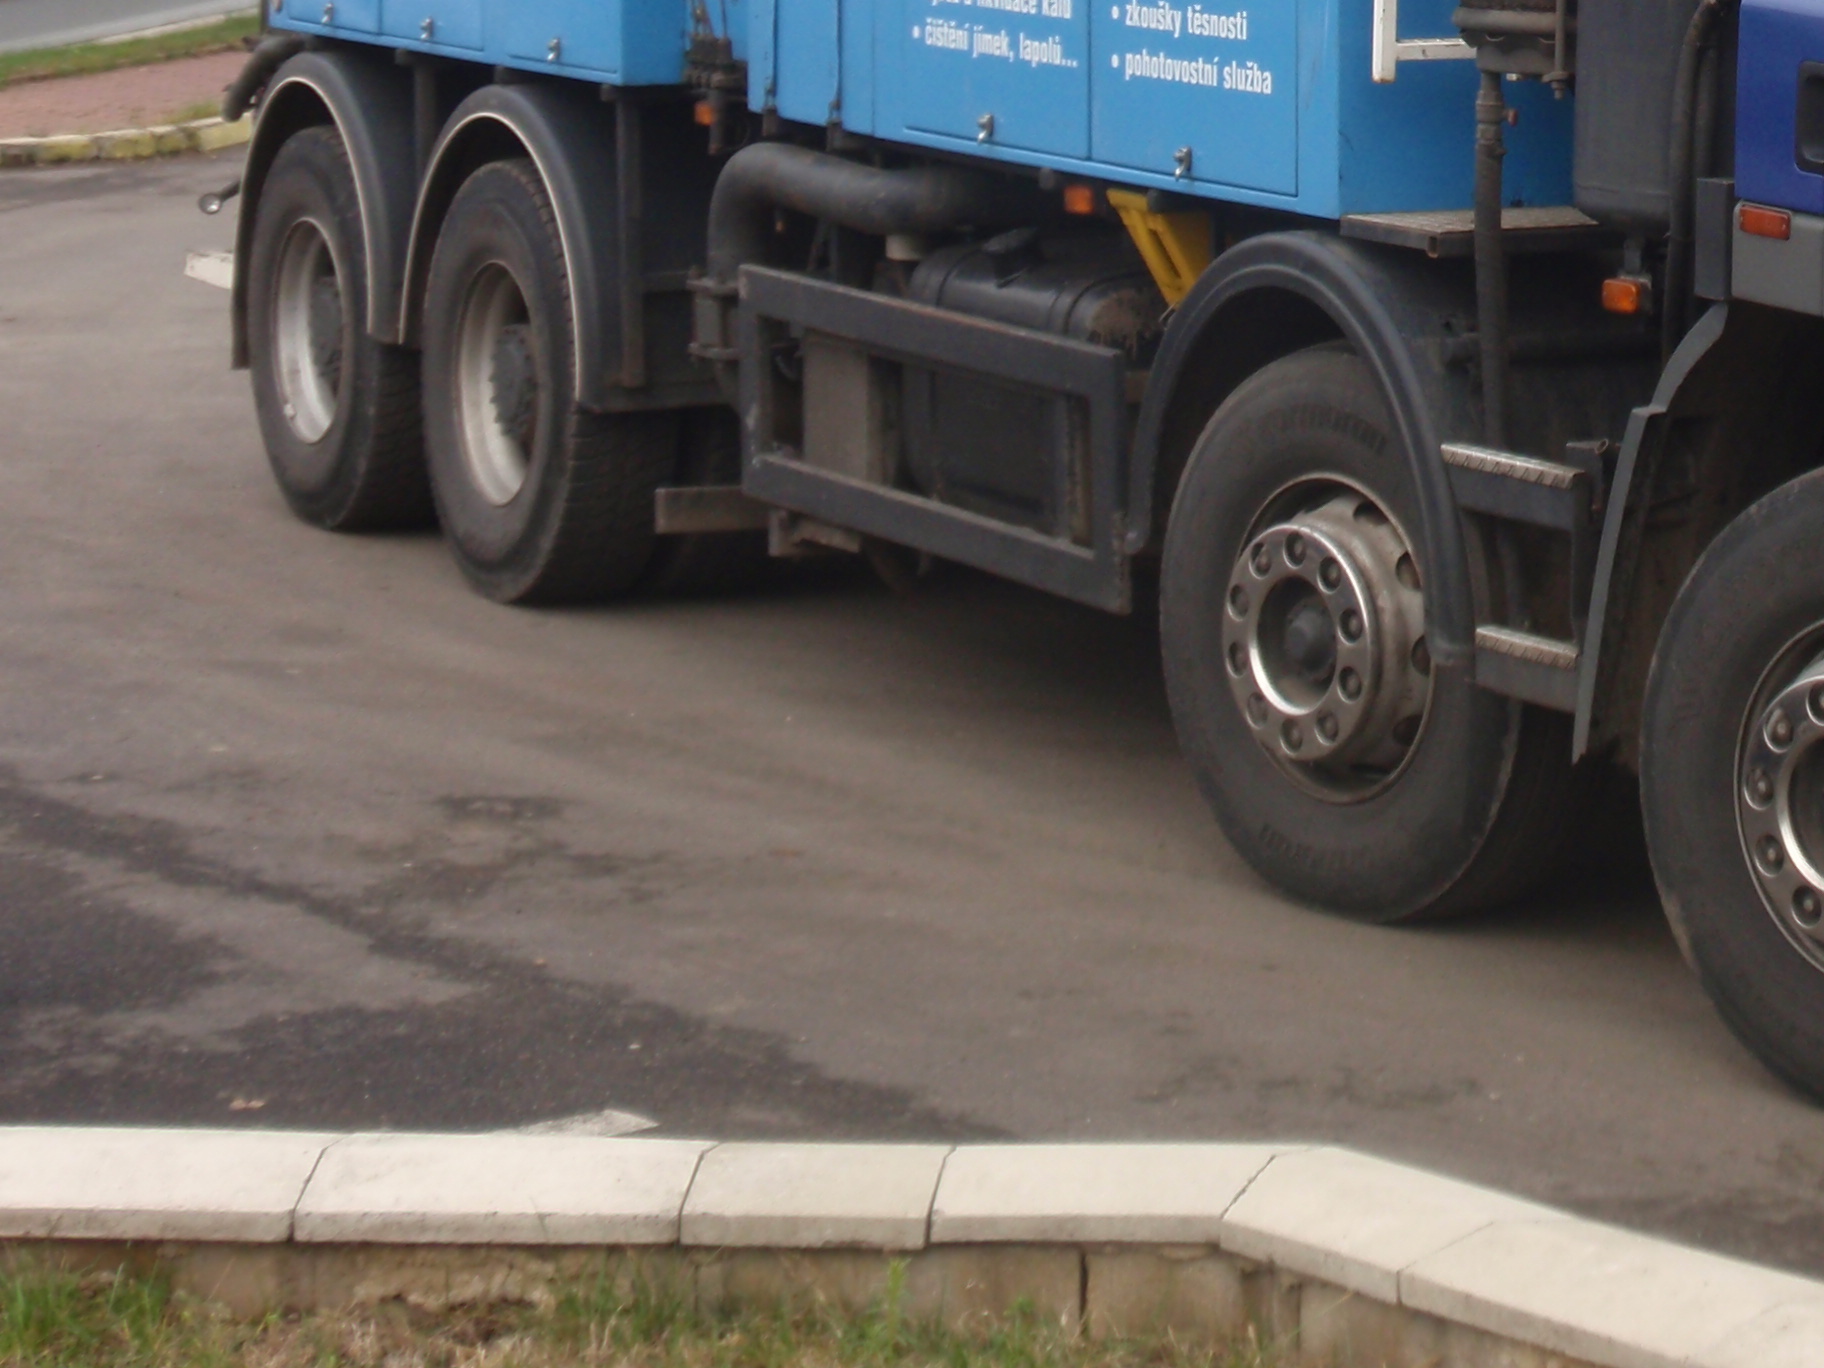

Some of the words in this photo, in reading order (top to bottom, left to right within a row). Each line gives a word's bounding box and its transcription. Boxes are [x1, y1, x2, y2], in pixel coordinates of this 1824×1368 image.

[924, 17, 969, 51] čištění
[1187, 4, 1248, 41] těsnosti
[1125, 48, 1220, 87] pohotovostní
[1223, 61, 1272, 95] služba
